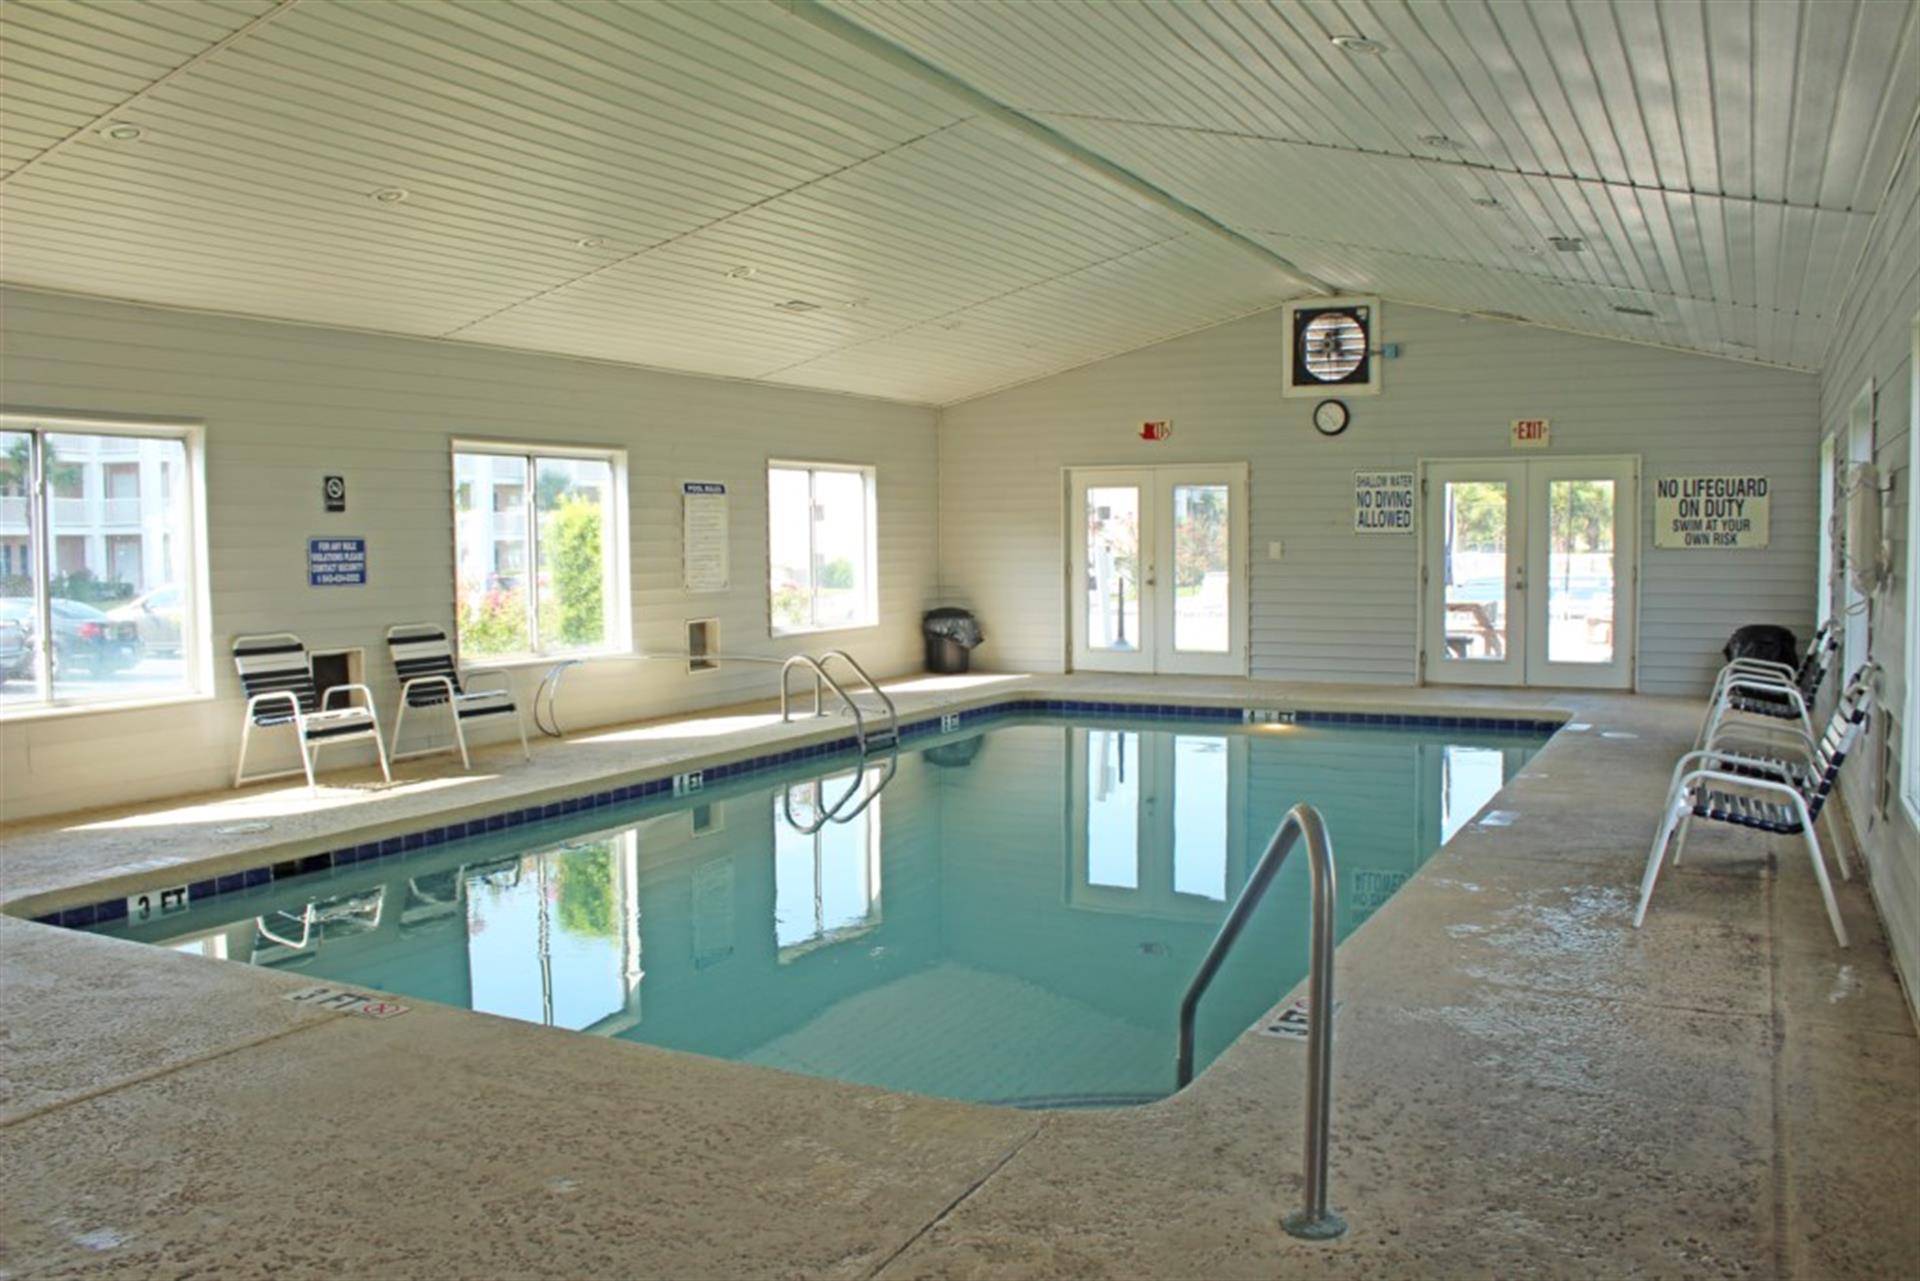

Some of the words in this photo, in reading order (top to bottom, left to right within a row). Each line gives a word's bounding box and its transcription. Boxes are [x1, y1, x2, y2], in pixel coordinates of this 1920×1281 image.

[1518, 421, 1543, 440] EXIT
[1658, 479, 1679, 498] NO
[1683, 478, 1768, 497] LIFEGUARD
[1357, 491, 1372, 508] NO
[1376, 491, 1412, 508] DIVING
[1679, 499, 1699, 517] ON
[1705, 499, 1744, 517] DUTY
[1357, 510, 1411, 528] ALLOWED
[1672, 519, 1702, 532] SWIM
[1705, 519, 1717, 531] AT
[1722, 519, 1750, 531] YOUR
[1685, 533, 1710, 545] OWN
[1713, 533, 1737, 545] RISK
[161, 888, 186, 914] FT
[317, 992, 370, 1009] FT
